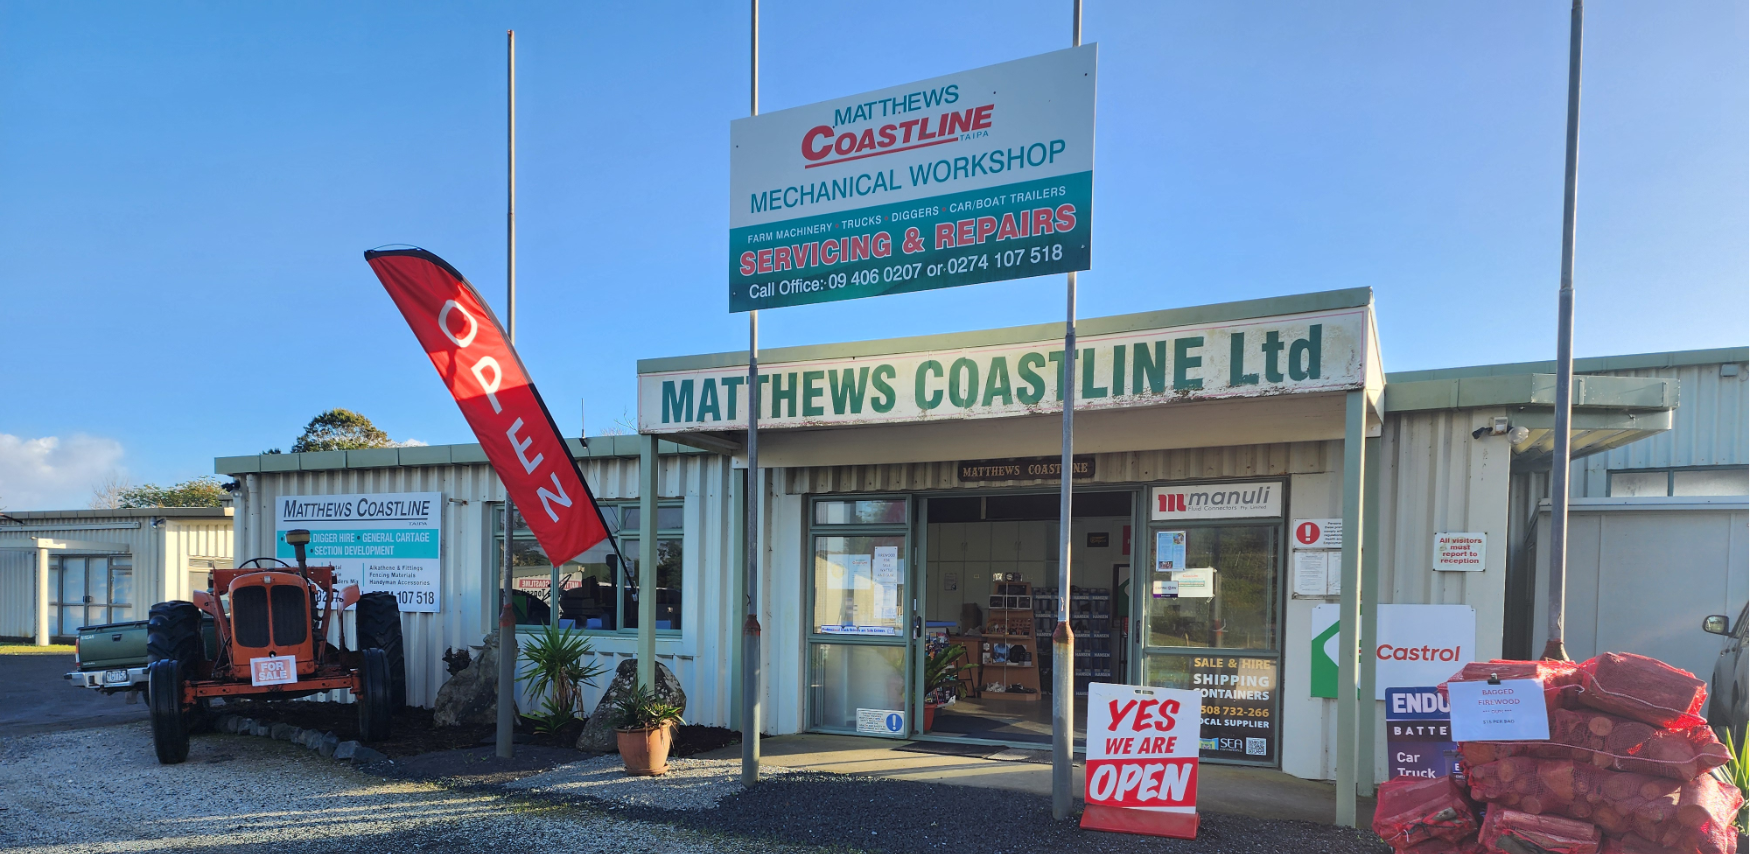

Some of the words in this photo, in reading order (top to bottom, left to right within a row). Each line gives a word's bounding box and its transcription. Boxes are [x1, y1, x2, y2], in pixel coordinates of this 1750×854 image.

[834, 85, 959, 126] MATTHEWS
[801, 104, 994, 161] COASTLINE
[960, 130, 989, 142] TAIPA
[751, 169, 902, 214] MECHANICAL
[910, 139, 1066, 187] WORKSHOP
[748, 231, 773, 244] FARM
[776, 222, 832, 240] MACHINERY
[842, 216, 882, 229] TRUCKS
[892, 206, 939, 222] DIGGERS
[949, 196, 1008, 213] CAR/BOAT
[1010, 186, 1066, 204] TRAILERS
[740, 232, 892, 276] SERVICING
[902, 228, 924, 254] &
[935, 204, 1076, 250] REPAIRS
[749, 282, 775, 299] Call
[780, 277, 824, 296] Office:
[828, 274, 847, 289] 09
[851, 270, 879, 286] 406
[884, 263, 922, 282] 0207
[927, 264, 942, 276] or
[948, 256, 988, 274] 0274
[994, 249, 1024, 268] 107
[1030, 244, 1062, 262] 518
[662, 364, 896, 424] MATTHEWS
[914, 336, 1204, 411] COASTLINE
[1230, 324, 1322, 385] Ltd
[438, 299, 572, 523] OPEN
[963, 466, 1020, 478] MATTHEWS
[1028, 462, 1088, 475] COASTNE
[1188, 486, 1270, 506] manuli
[284, 500, 352, 518] MATTHEWS
[357, 498, 430, 517] COASTLINE
[313, 534, 338, 543] DIGGER
[339, 534, 355, 543] HIRE
[362, 533, 394, 543] GENERAL
[396, 532, 430, 542] CARTAGE
[314, 546, 342, 556] SECTION
[344, 546, 394, 556] DEVELOPMENT
[398, 591, 414, 604] 107
[416, 591, 434, 604] 518
[1376, 644, 1461, 662] Castrol
[261, 662, 284, 672] FOR
[1194, 658, 1223, 668] SALE
[1228, 659, 1237, 668] &
[1242, 658, 1270, 670] HIRE
[259, 670, 287, 680] SALE
[1194, 674, 1269, 687] SHIPPING
[1223, 706, 1269, 717] 732-266
[1392, 693, 1450, 713] ENDU
[1108, 699, 1180, 732] YES
[1224, 719, 1269, 728] SUPPLIER
[1393, 726, 1448, 735] BATTE
[1106, 738, 1134, 755] WE
[1137, 736, 1177, 754] ARE
[1220, 738, 1242, 749] SEA
[1397, 752, 1420, 763] Car
[1397, 767, 1436, 778] Truck
[1089, 763, 1193, 802] OPEN
